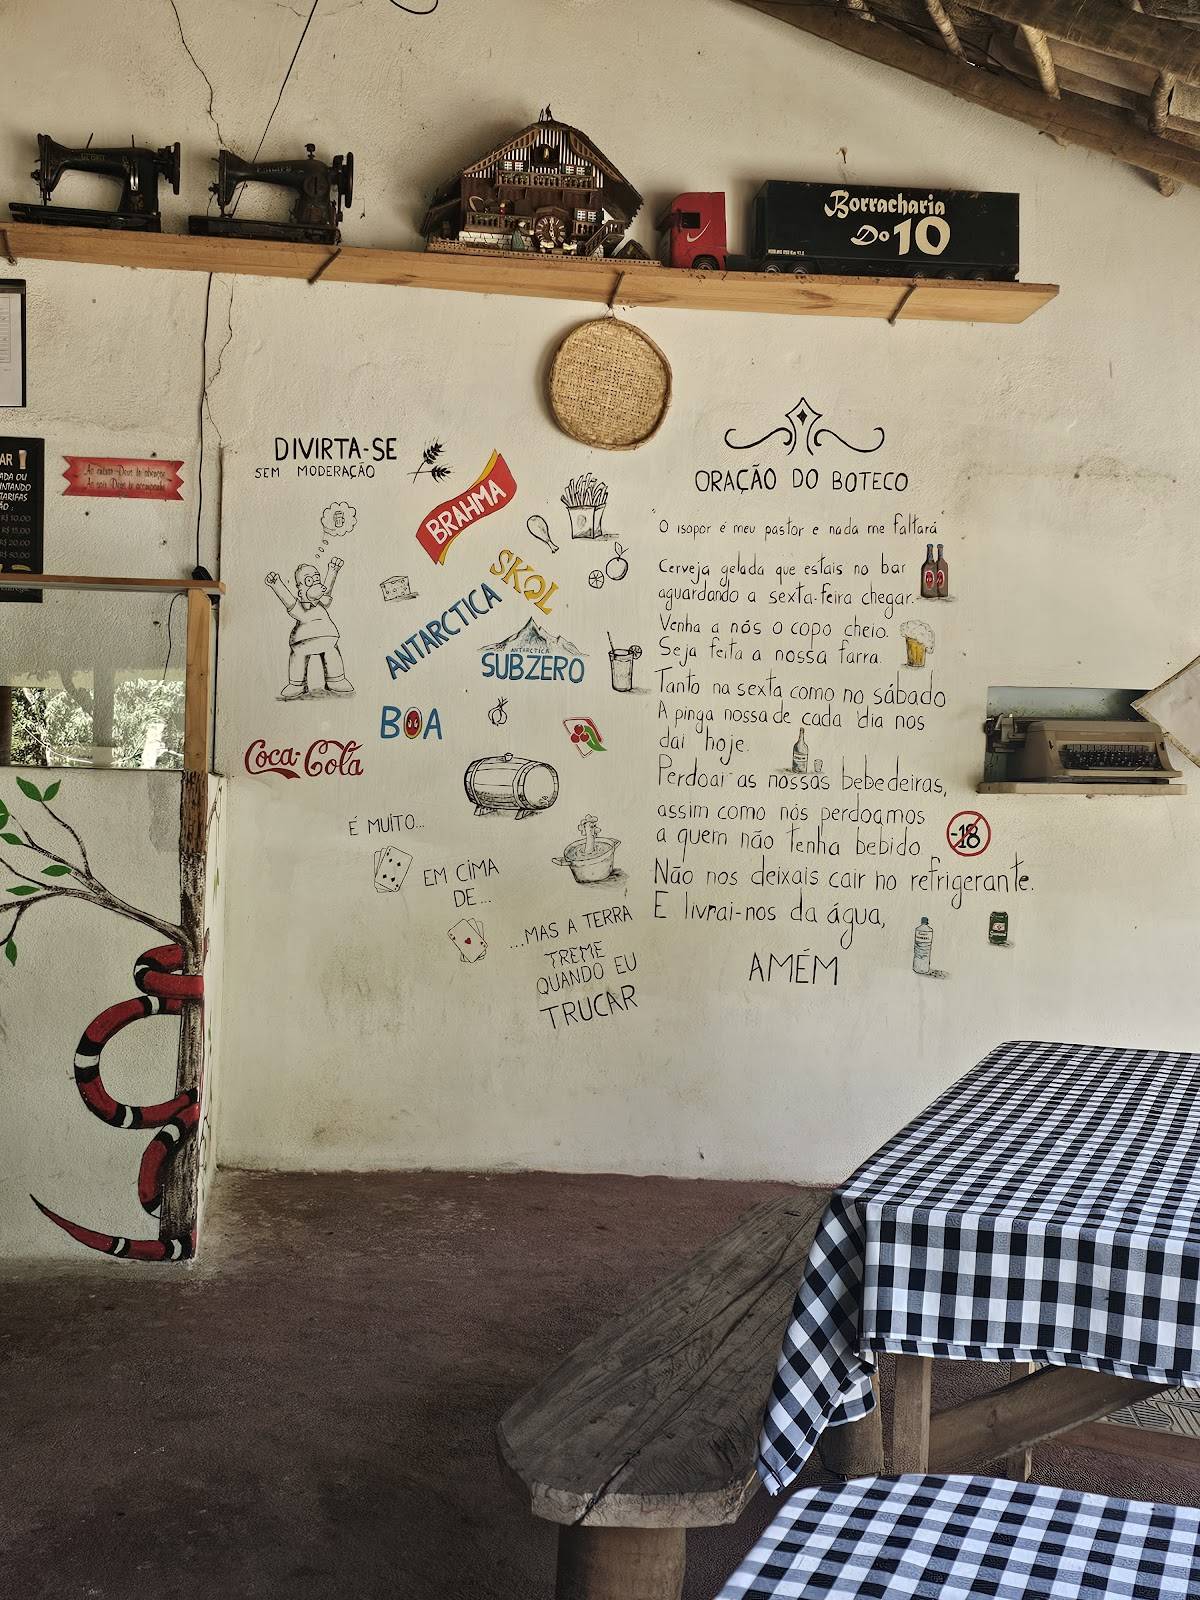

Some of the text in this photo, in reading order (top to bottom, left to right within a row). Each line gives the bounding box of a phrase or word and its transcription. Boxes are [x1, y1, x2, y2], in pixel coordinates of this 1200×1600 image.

[824, 190, 946, 219] Borracharia
[850, 216, 951, 256] Do 10
[275, 437, 398, 461] DIVIRTA-SE
[254, 461, 376, 480] SEM MODERAÇÃO
[695, 464, 909, 494] ORAÇÃO DO BOTECO
[426, 479, 507, 545] BRAHMA
[719, 522, 726, 534] é
[733, 524, 756, 534] meu
[765, 517, 804, 541] pastor
[812, 525, 819, 535] e
[829, 517, 859, 535] nada
[867, 524, 885, 534] me
[489, 549, 560, 615] SKOL
[659, 551, 905, 587] Cerveja gelada que estais no bar
[658, 580, 739, 610] aguardando
[748, 592, 756, 602] a
[861, 581, 914, 619] chegar.
[385, 582, 502, 680] ANTARCTICA
[660, 613, 701, 633] Venha
[711, 623, 719, 633] a
[731, 620, 761, 637] nós
[790, 623, 832, 649] copo
[844, 616, 889, 639] cheio.
[659, 636, 697, 667] Seja
[709, 637, 743, 660] feita
[752, 650, 761, 662] a
[775, 648, 827, 665] nossa
[654, 666, 946, 708] Tanto na sexta como no sábado
[380, 705, 443, 740] BOA
[658, 700, 925, 733] A pinga nossa de cada dia nos
[659, 727, 684, 750] dai
[244, 739, 364, 779] Coca-Cola
[737, 774, 757, 788] as
[768, 773, 830, 790] nossas
[841, 755, 947, 797] bebedeiras,
[349, 816, 359, 836] É
[657, 793, 926, 840] assim como nós perdoamos
[656, 825, 921, 862] a quem não tenha bebido
[423, 867, 448, 887] EM
[654, 851, 1035, 910] Não nos deixais cair no refrigerante.
[568, 918, 578, 934] A
[582, 905, 633, 929] TERRA
[654, 890, 886, 950] E livrai-nos da água,
[544, 940, 605, 968] TREME
[749, 948, 839, 986] AMÉM
[536, 951, 638, 995] QUANDO EU
[539, 984, 638, 1029] TRUCAR
